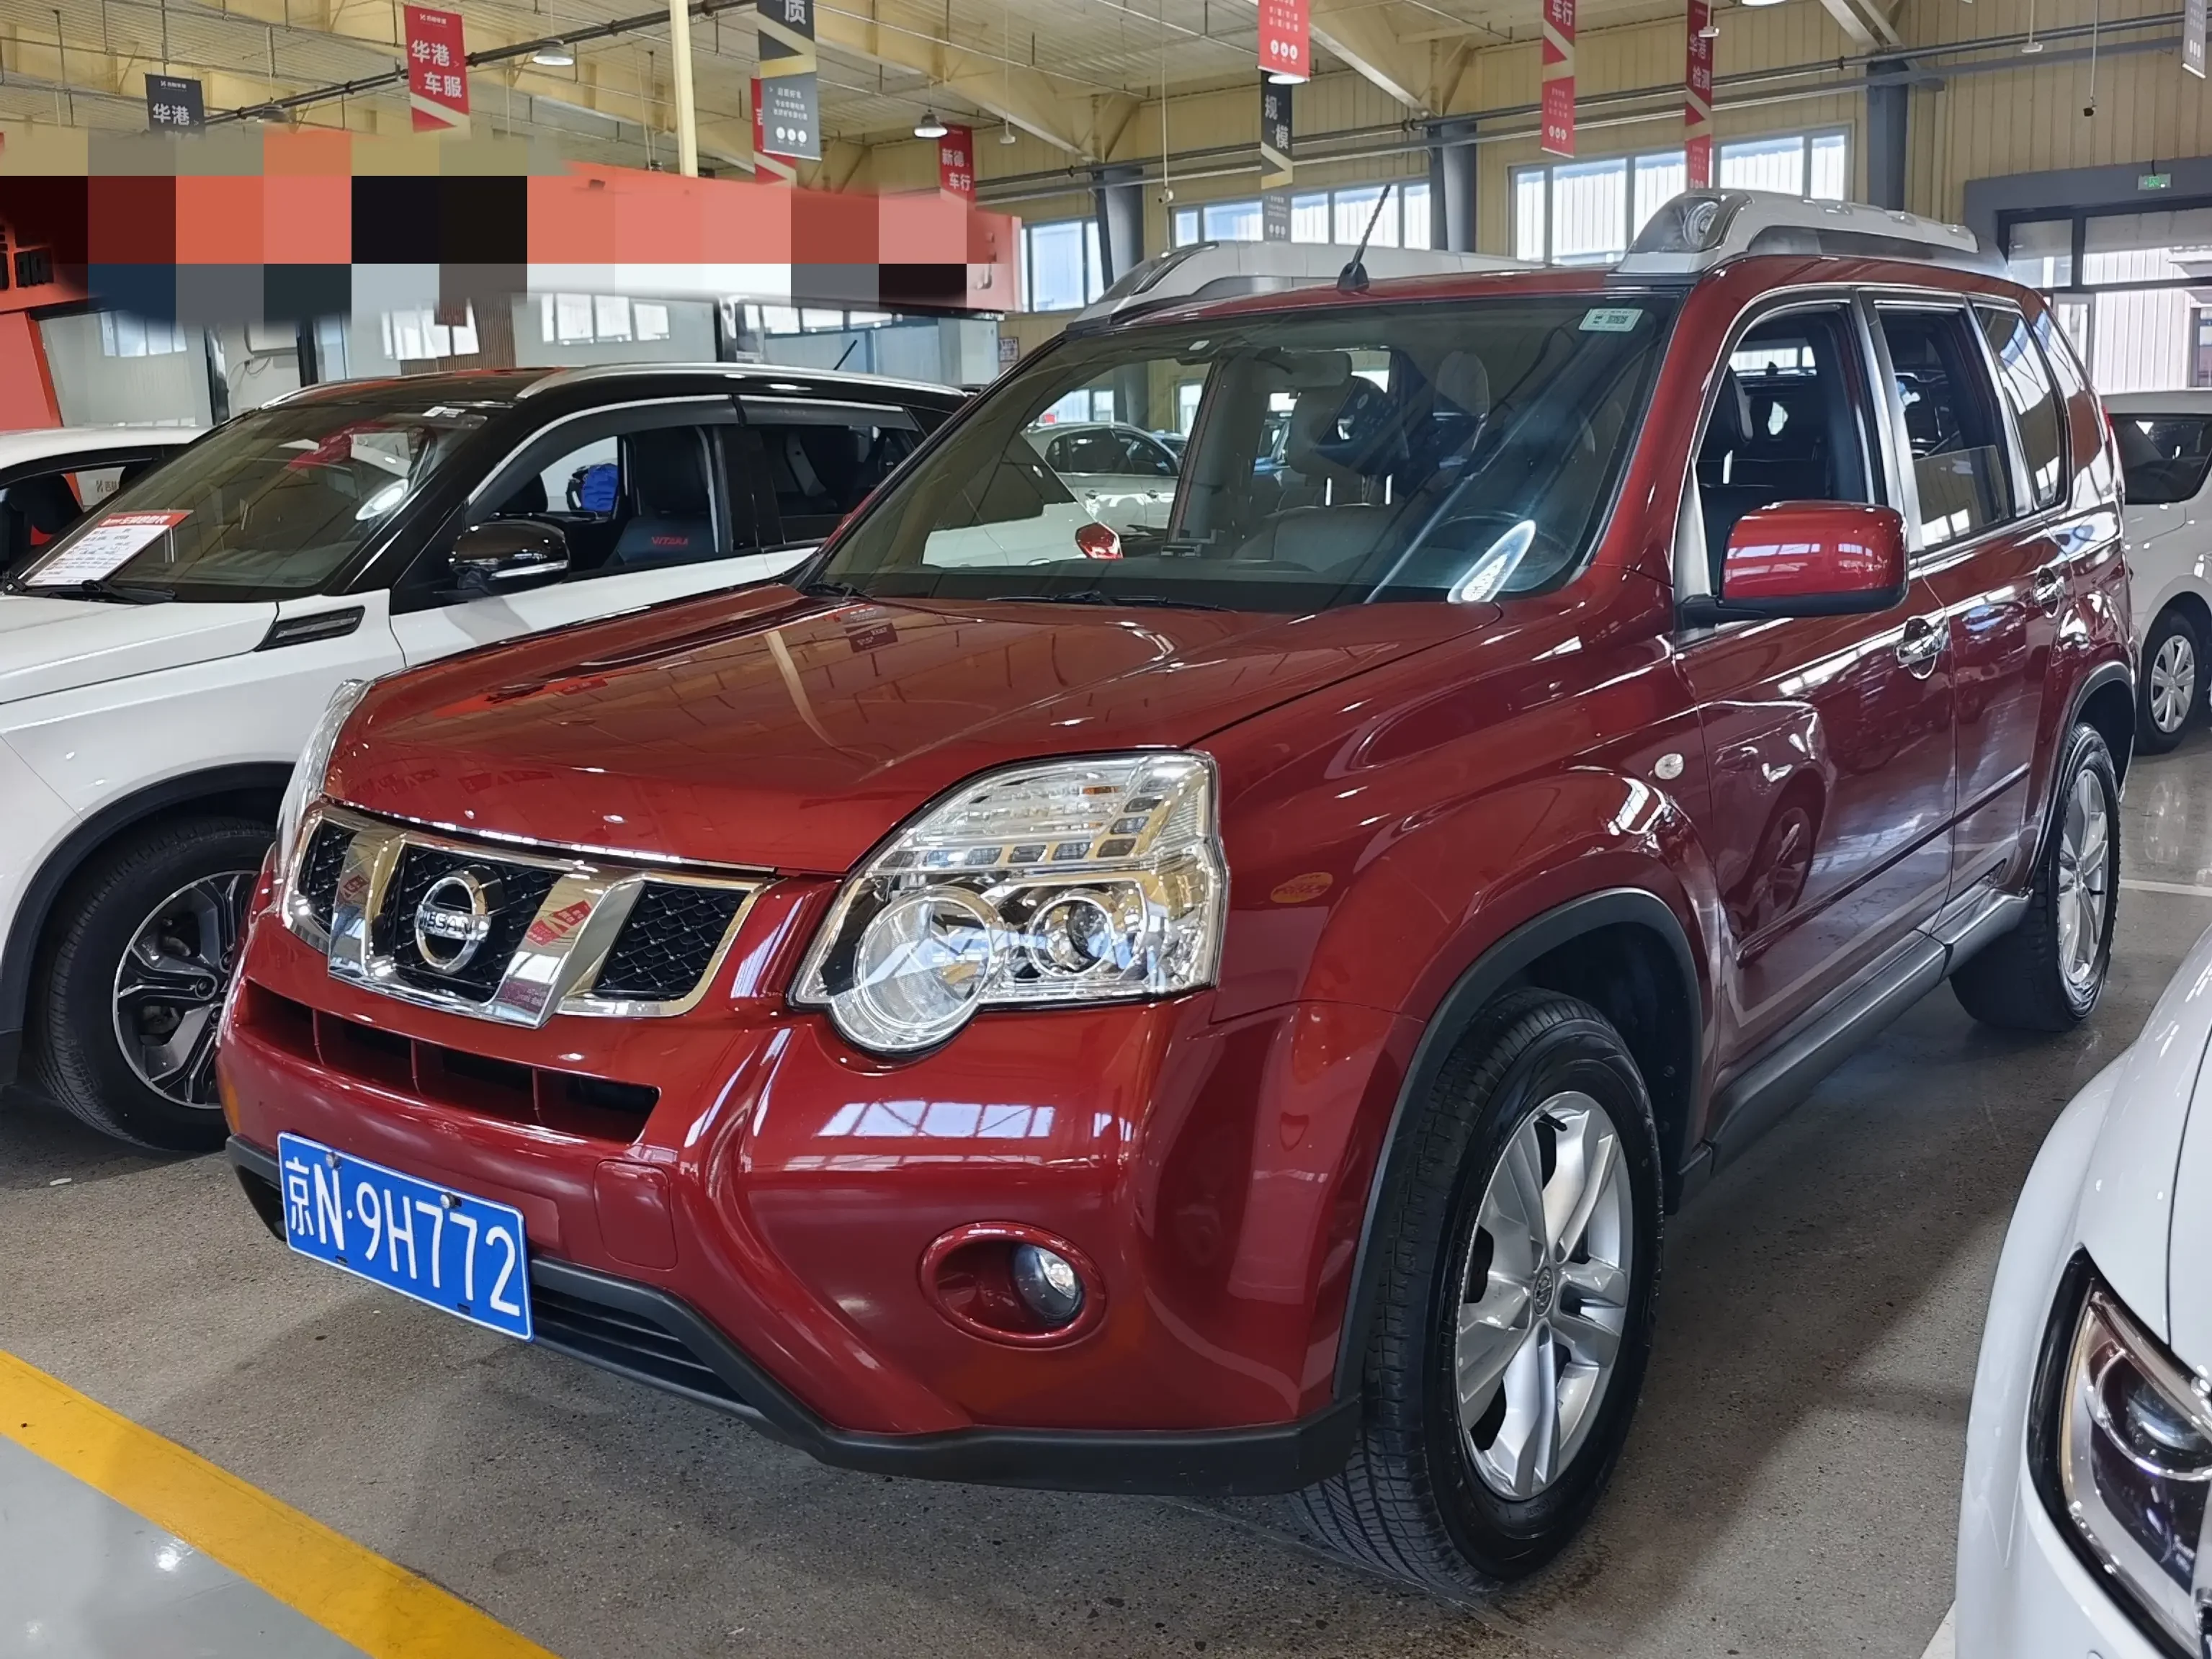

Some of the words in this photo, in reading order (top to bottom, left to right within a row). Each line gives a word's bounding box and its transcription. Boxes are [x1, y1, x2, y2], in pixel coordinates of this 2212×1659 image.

[1551, 0, 1573, 26] 车行
[411, 39, 450, 67] 华港
[424, 71, 462, 99] 车服
[153, 103, 190, 125] 华港
[949, 171, 971, 192] 车行
[651, 536, 689, 546] VITARA
